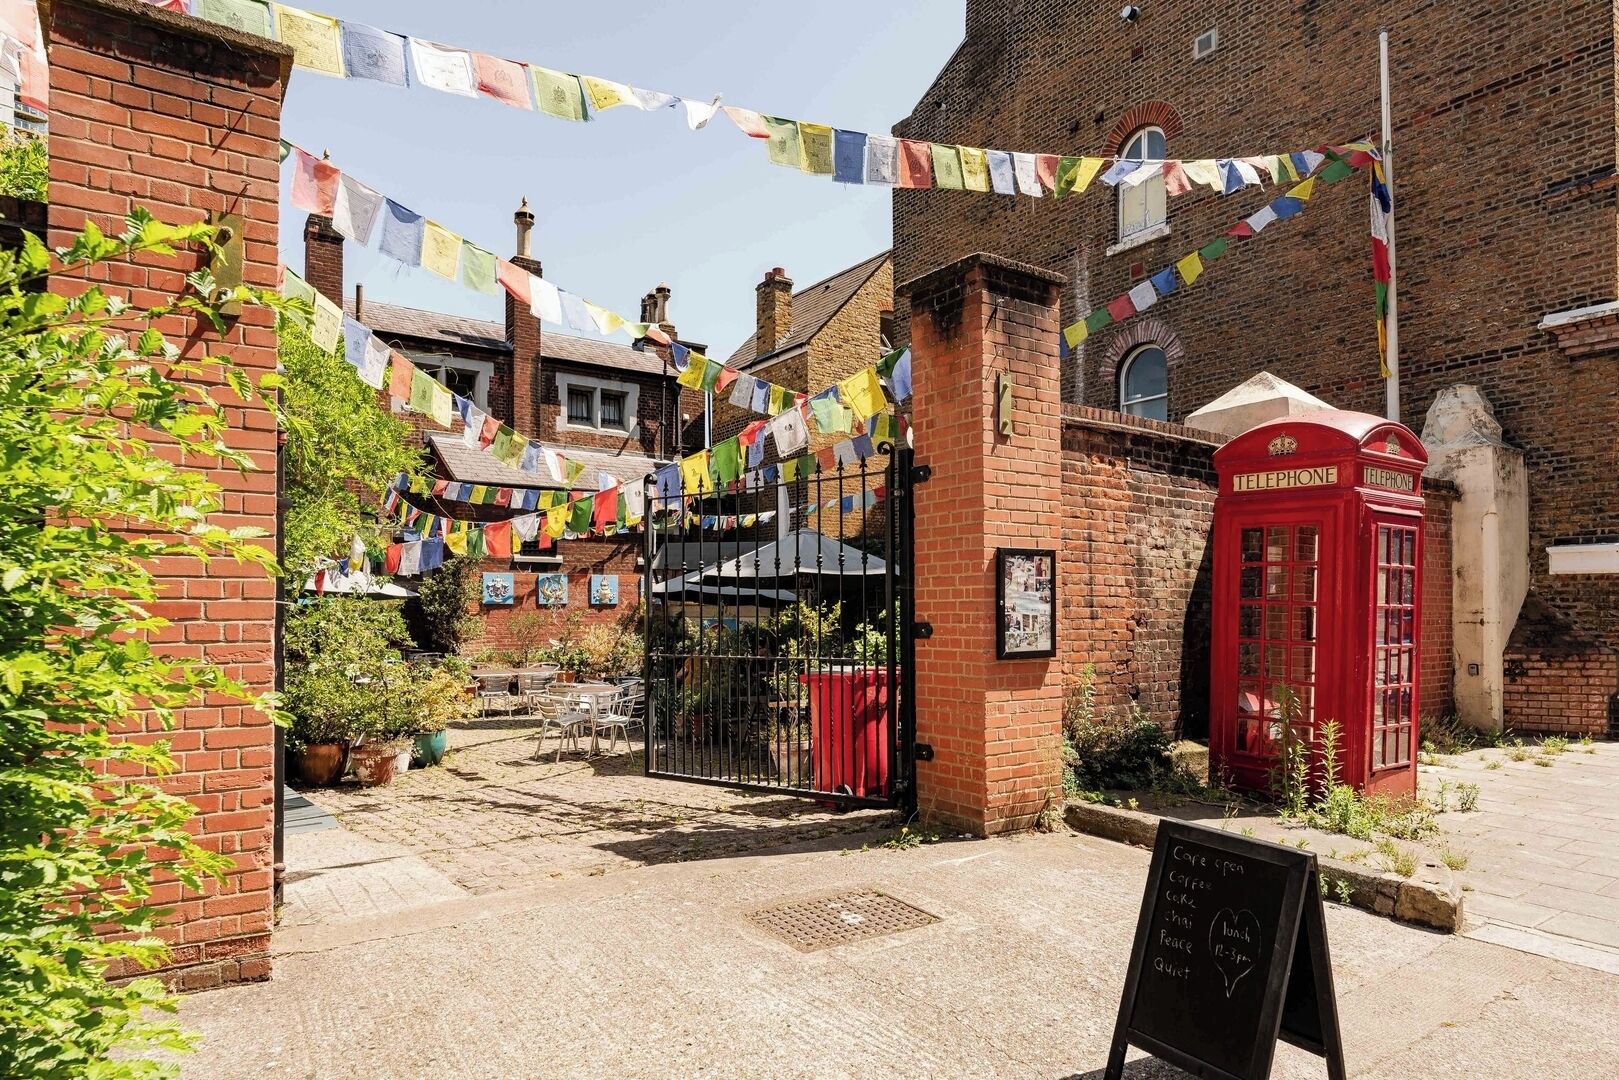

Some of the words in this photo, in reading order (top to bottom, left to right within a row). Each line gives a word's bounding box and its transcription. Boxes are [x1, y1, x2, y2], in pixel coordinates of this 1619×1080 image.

[1235, 468, 1335, 490] TELEPHONE
[1364, 468, 1412, 491] TELEPHONE
[1214, 858, 1245, 877] open
[1160, 928, 1193, 954] Peace
[1223, 920, 1250, 943] lunch
[1214, 943, 1252, 964] 12-3pm
[1154, 957, 1191, 980] Quiet
